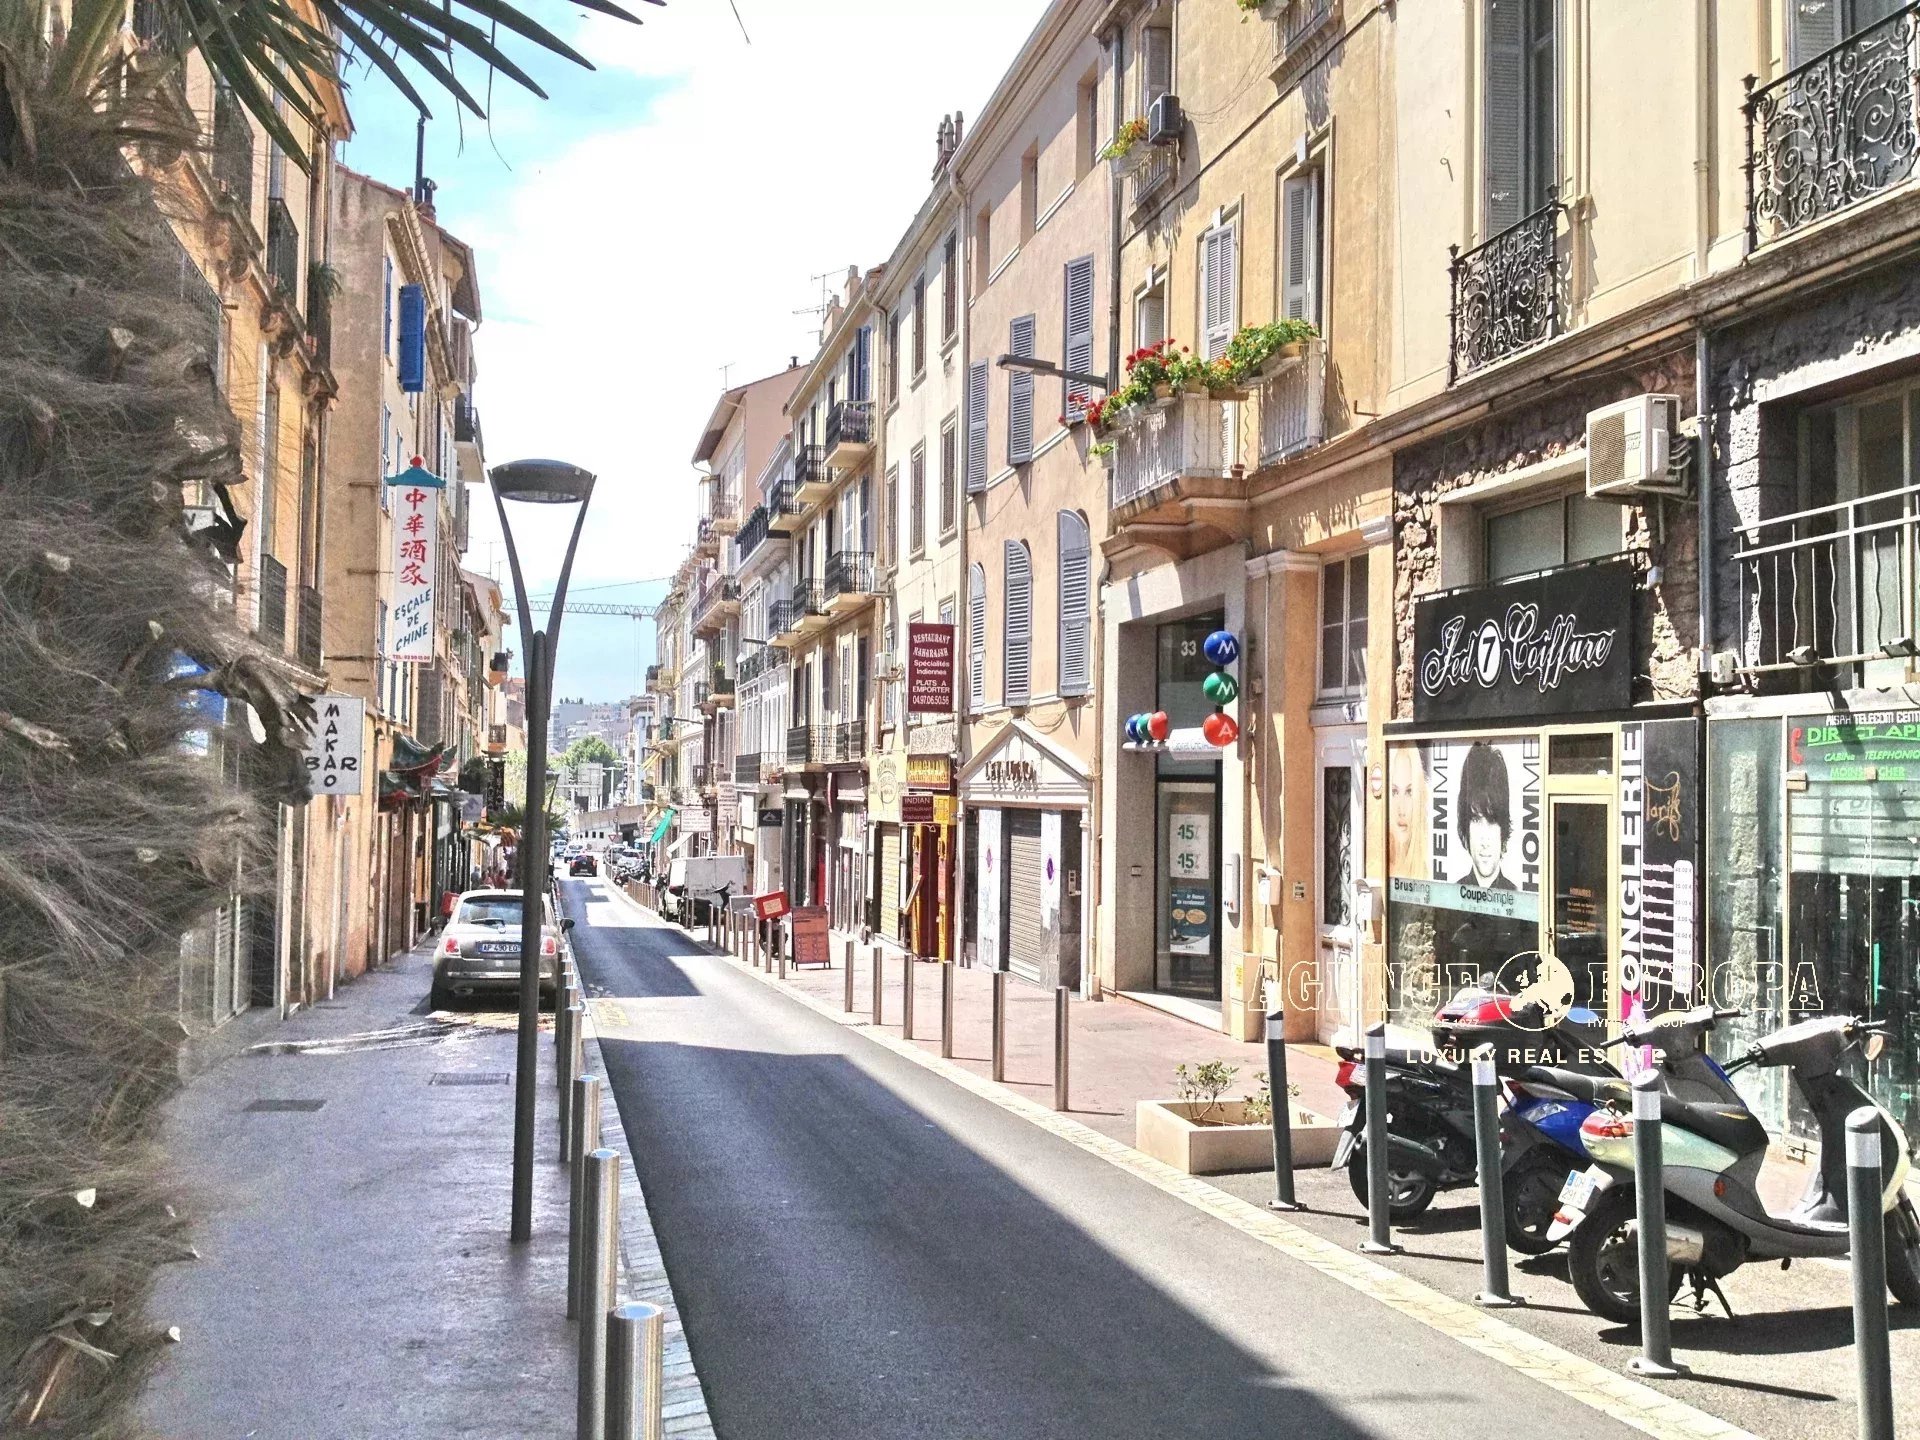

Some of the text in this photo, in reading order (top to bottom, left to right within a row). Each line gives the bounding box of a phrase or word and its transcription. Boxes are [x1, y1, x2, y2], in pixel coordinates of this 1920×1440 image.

[400, 488, 428, 586] 中華酒家
[395, 588, 431, 621] ESCALE
[407, 612, 419, 628] DE
[396, 622, 428, 652] CHINE
[913, 633, 950, 645] RESTAURANT
[1181, 640, 1197, 657] 33
[1508, 609, 1610, 686] Coiffure
[913, 659, 950, 668] Spécialités
[916, 668, 947, 676] Indiennes
[912, 685, 950, 694] EMPORTER
[915, 679, 937, 687] PLATS
[1807, 725, 1877, 743] DIRECT
[324, 703, 340, 787] MAKAO
[304, 754, 358, 771] BAR
[904, 797, 931, 805] INDIAN
[1433, 741, 1449, 881] FEMME
[1522, 738, 1540, 892] HOMME
[1620, 729, 1641, 992] ONGLERIE
